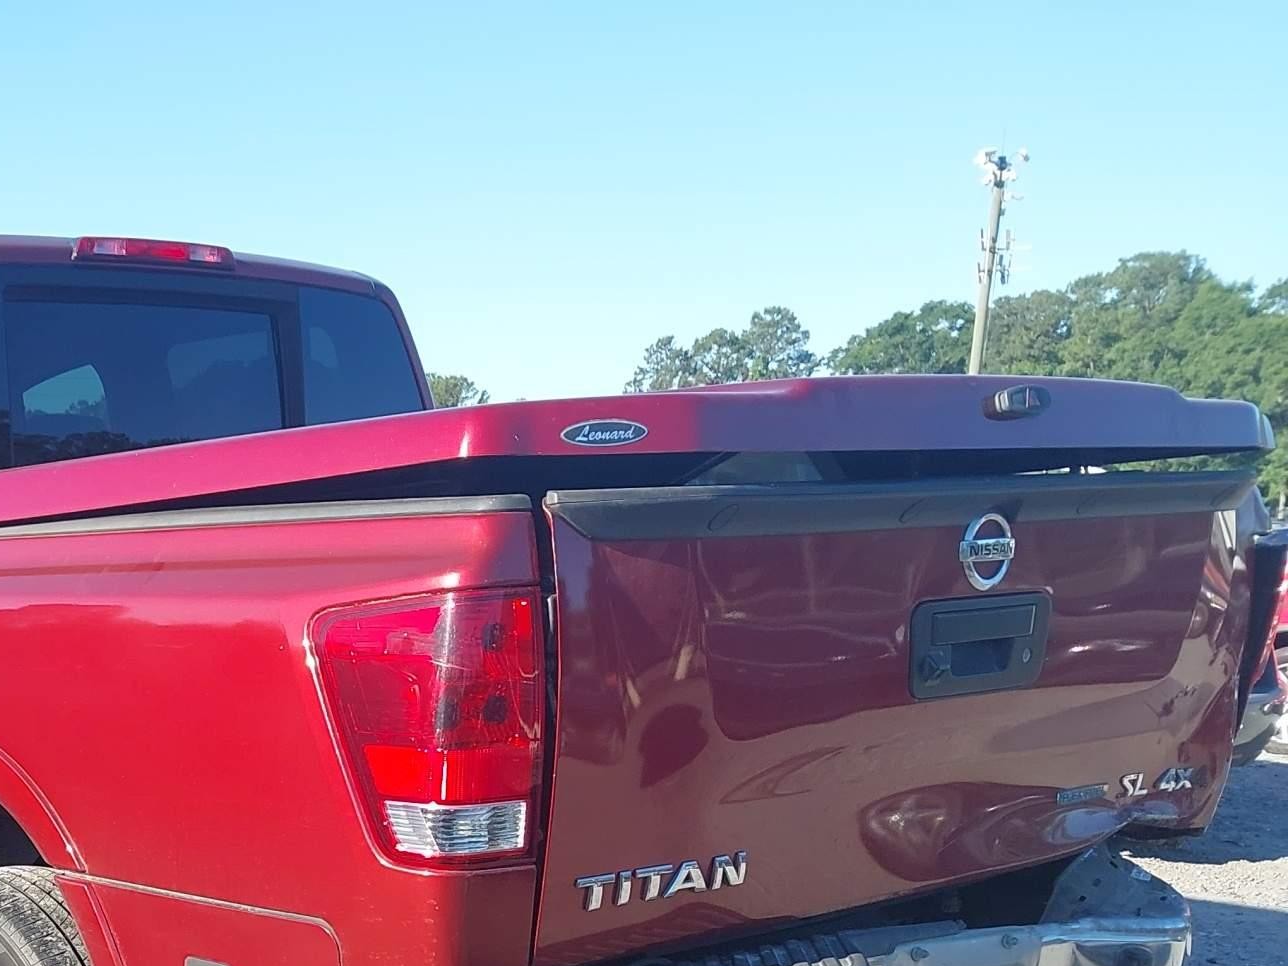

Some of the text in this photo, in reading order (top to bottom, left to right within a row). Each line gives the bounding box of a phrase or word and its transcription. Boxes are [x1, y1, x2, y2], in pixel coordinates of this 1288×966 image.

[575, 425, 635, 441] Leonard
[969, 540, 1013, 557] NISSAN
[1122, 772, 1148, 796] SL
[576, 852, 747, 912] TITAN
